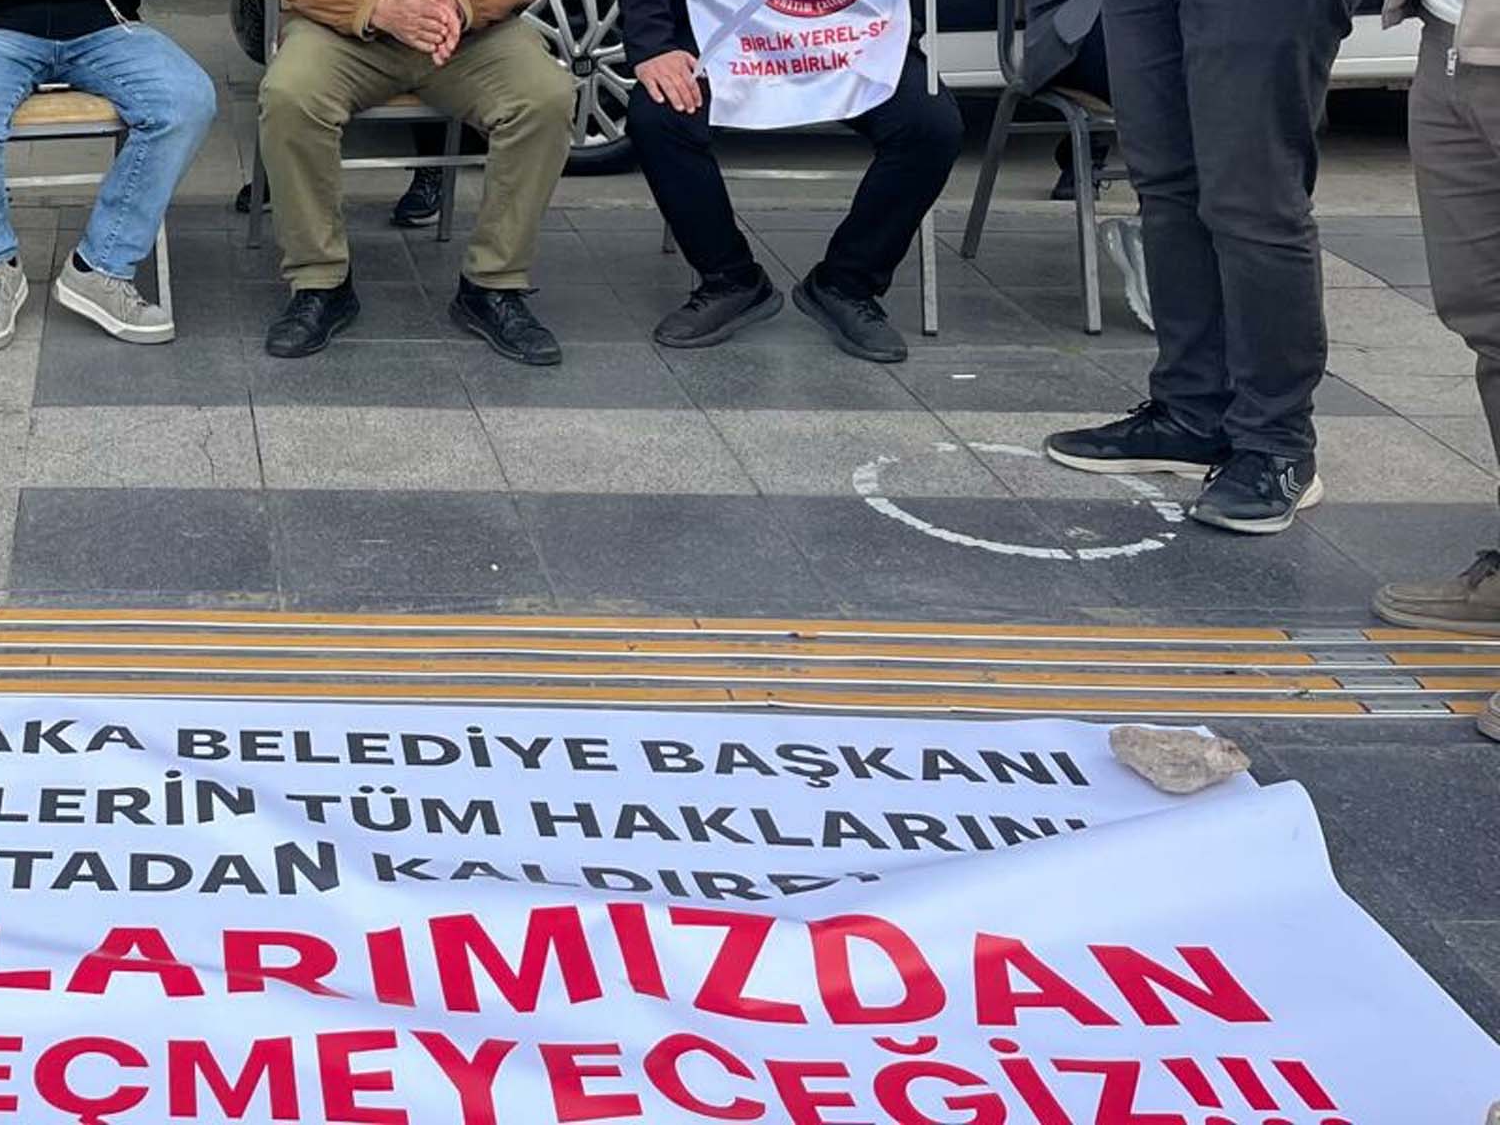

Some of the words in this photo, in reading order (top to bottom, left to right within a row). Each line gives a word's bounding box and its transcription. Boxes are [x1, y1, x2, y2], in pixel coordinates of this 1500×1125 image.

[739, 31, 795, 53] BİRLİK
[799, 20, 890, 48] YEREL-S
[791, 49, 851, 74] BİRLİK
[176, 724, 617, 773] BELEDİYE
[640, 737, 1090, 789] BAŞKANI
[287, 785, 501, 835] TÜM
[529, 801, 1090, 852] HAKLARIN
